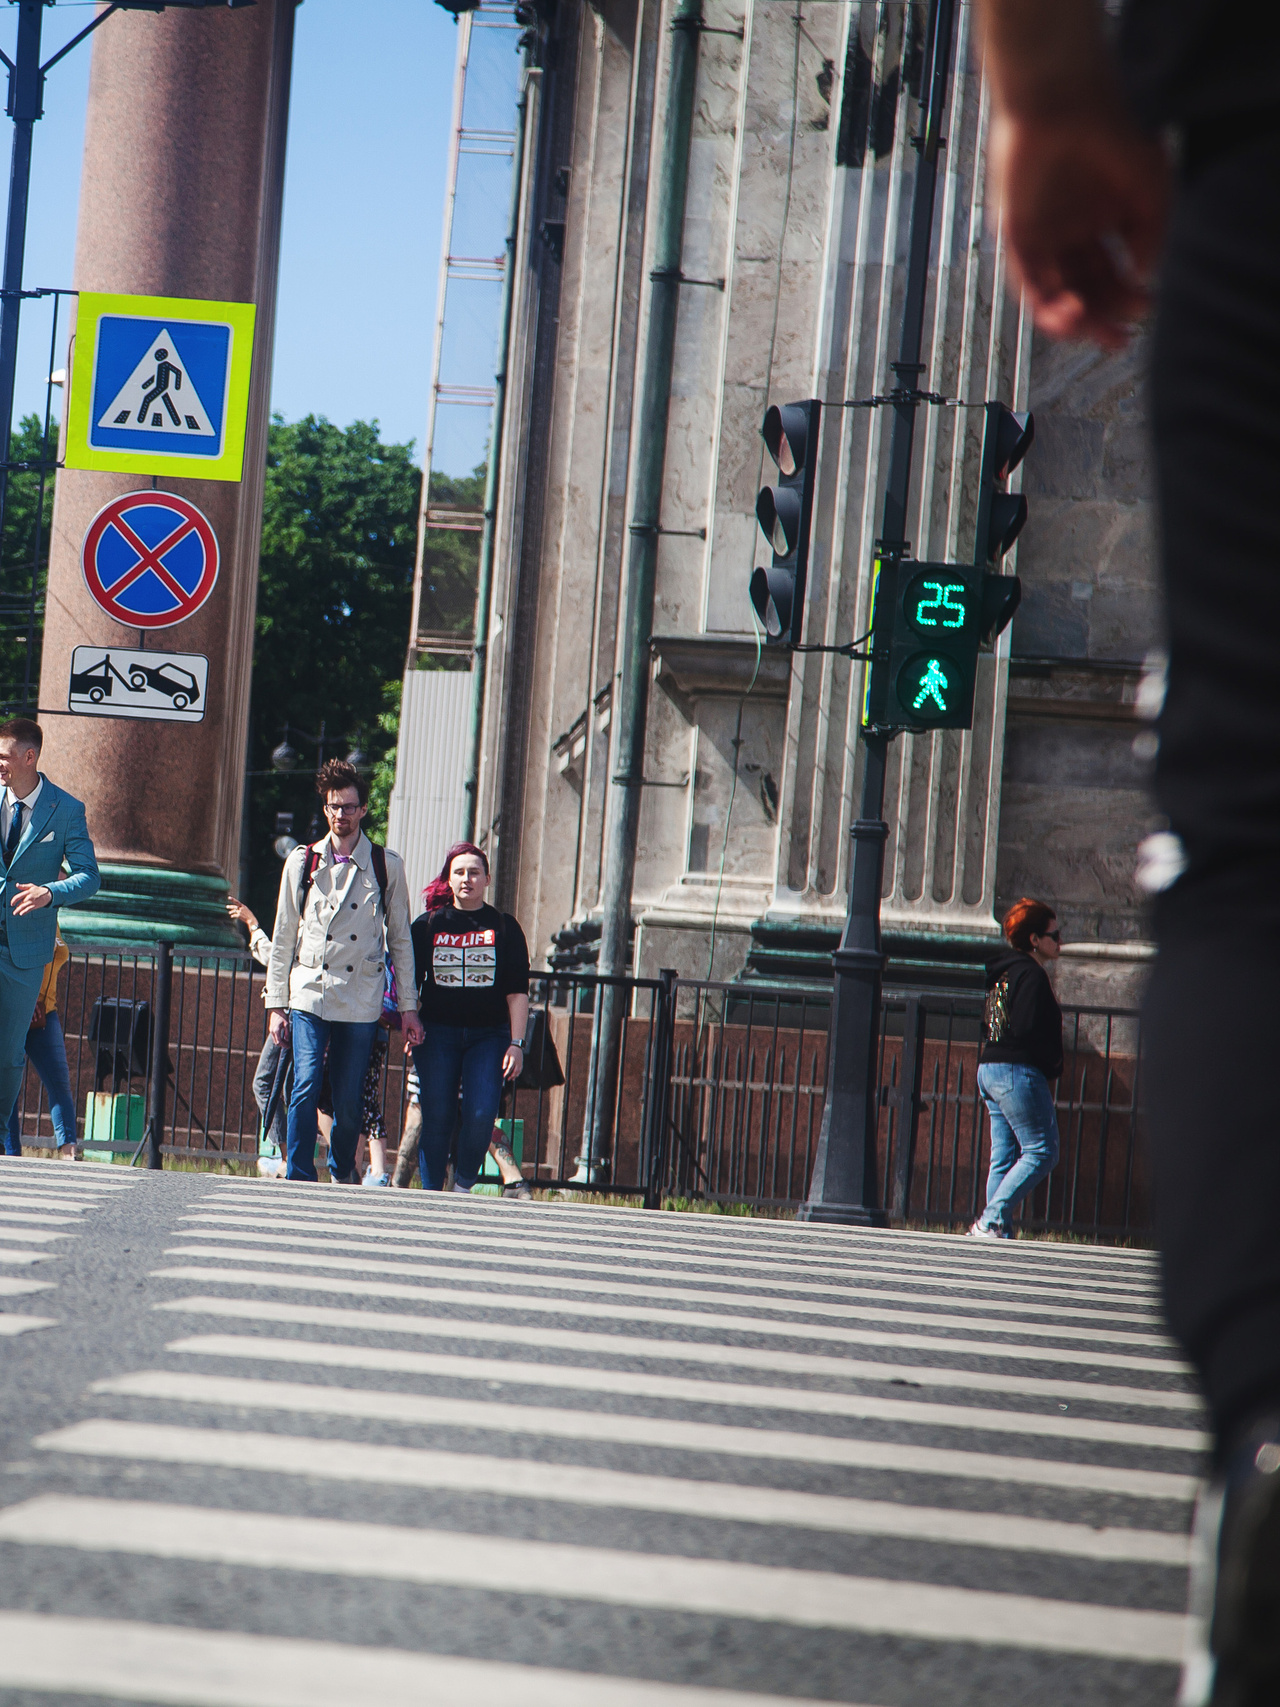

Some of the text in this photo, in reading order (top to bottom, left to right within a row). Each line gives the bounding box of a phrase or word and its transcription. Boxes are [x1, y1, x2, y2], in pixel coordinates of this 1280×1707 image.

[916, 581, 965, 628] 25
[436, 930, 493, 947] MY LIFE
